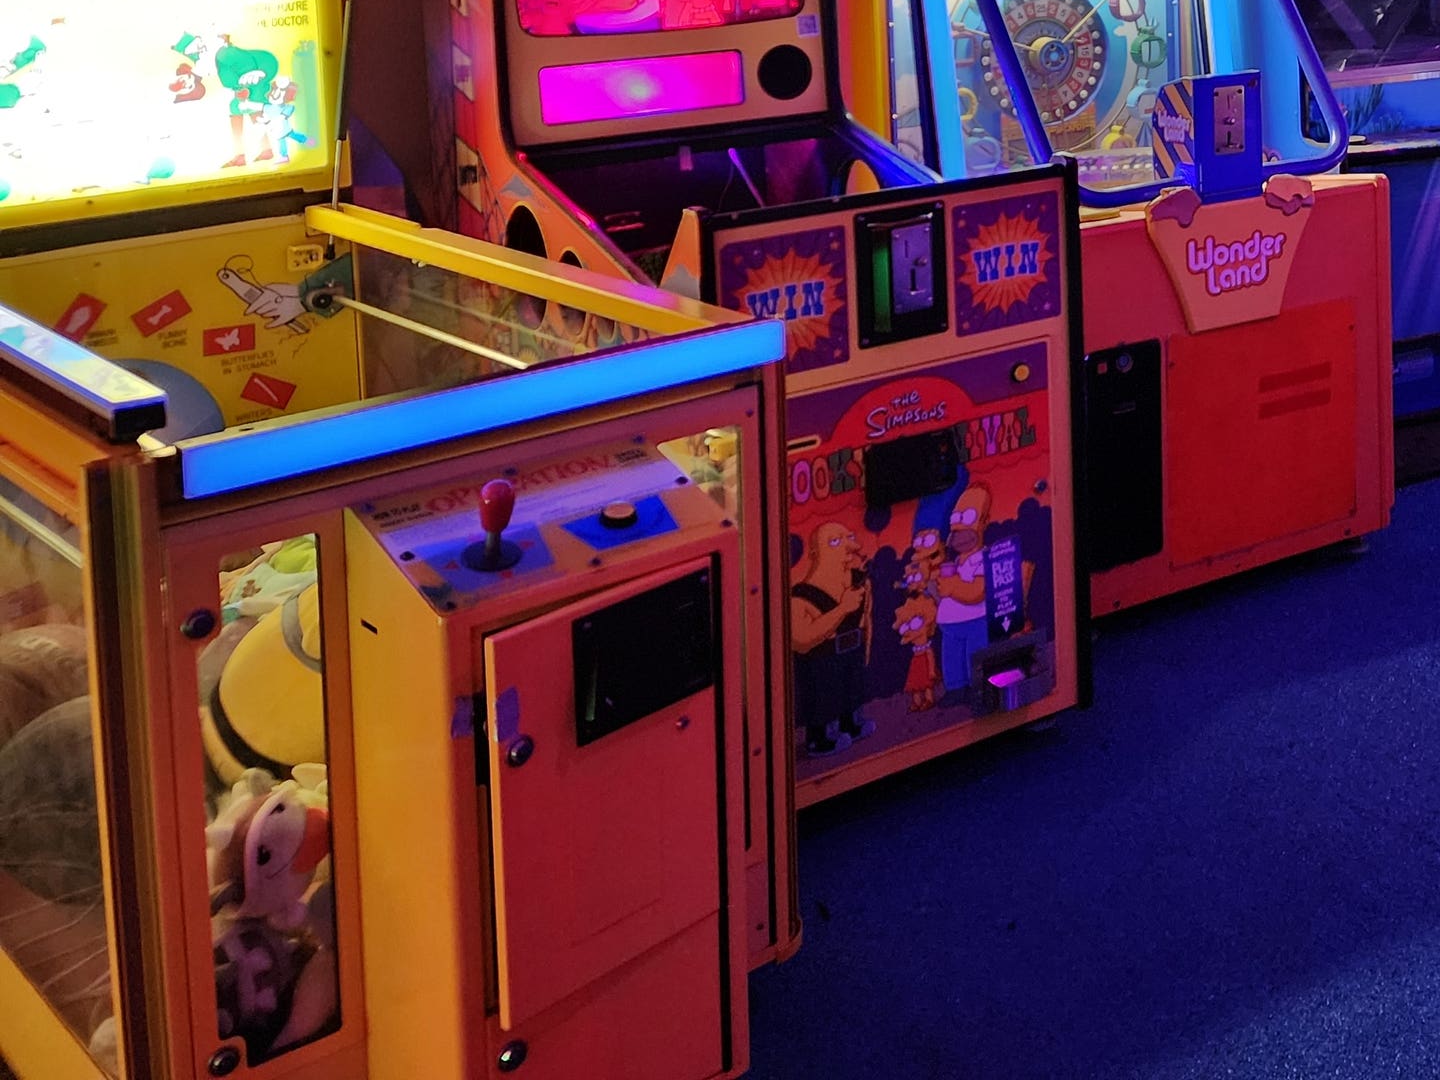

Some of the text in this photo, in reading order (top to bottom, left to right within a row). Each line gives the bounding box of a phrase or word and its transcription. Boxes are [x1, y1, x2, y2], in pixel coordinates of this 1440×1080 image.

[271, 14, 309, 27] DOCTOR
[973, 241, 1040, 284] WIN
[1187, 231, 1286, 272] Wonder
[1207, 254, 1269, 295] Land
[746, 280, 825, 322] WIN
[220, 350, 275, 368] BUTTERFLIES
[237, 358, 277, 372] STOMACH
[892, 391, 920, 409] THE
[867, 402, 946, 438] SIMPSONS
